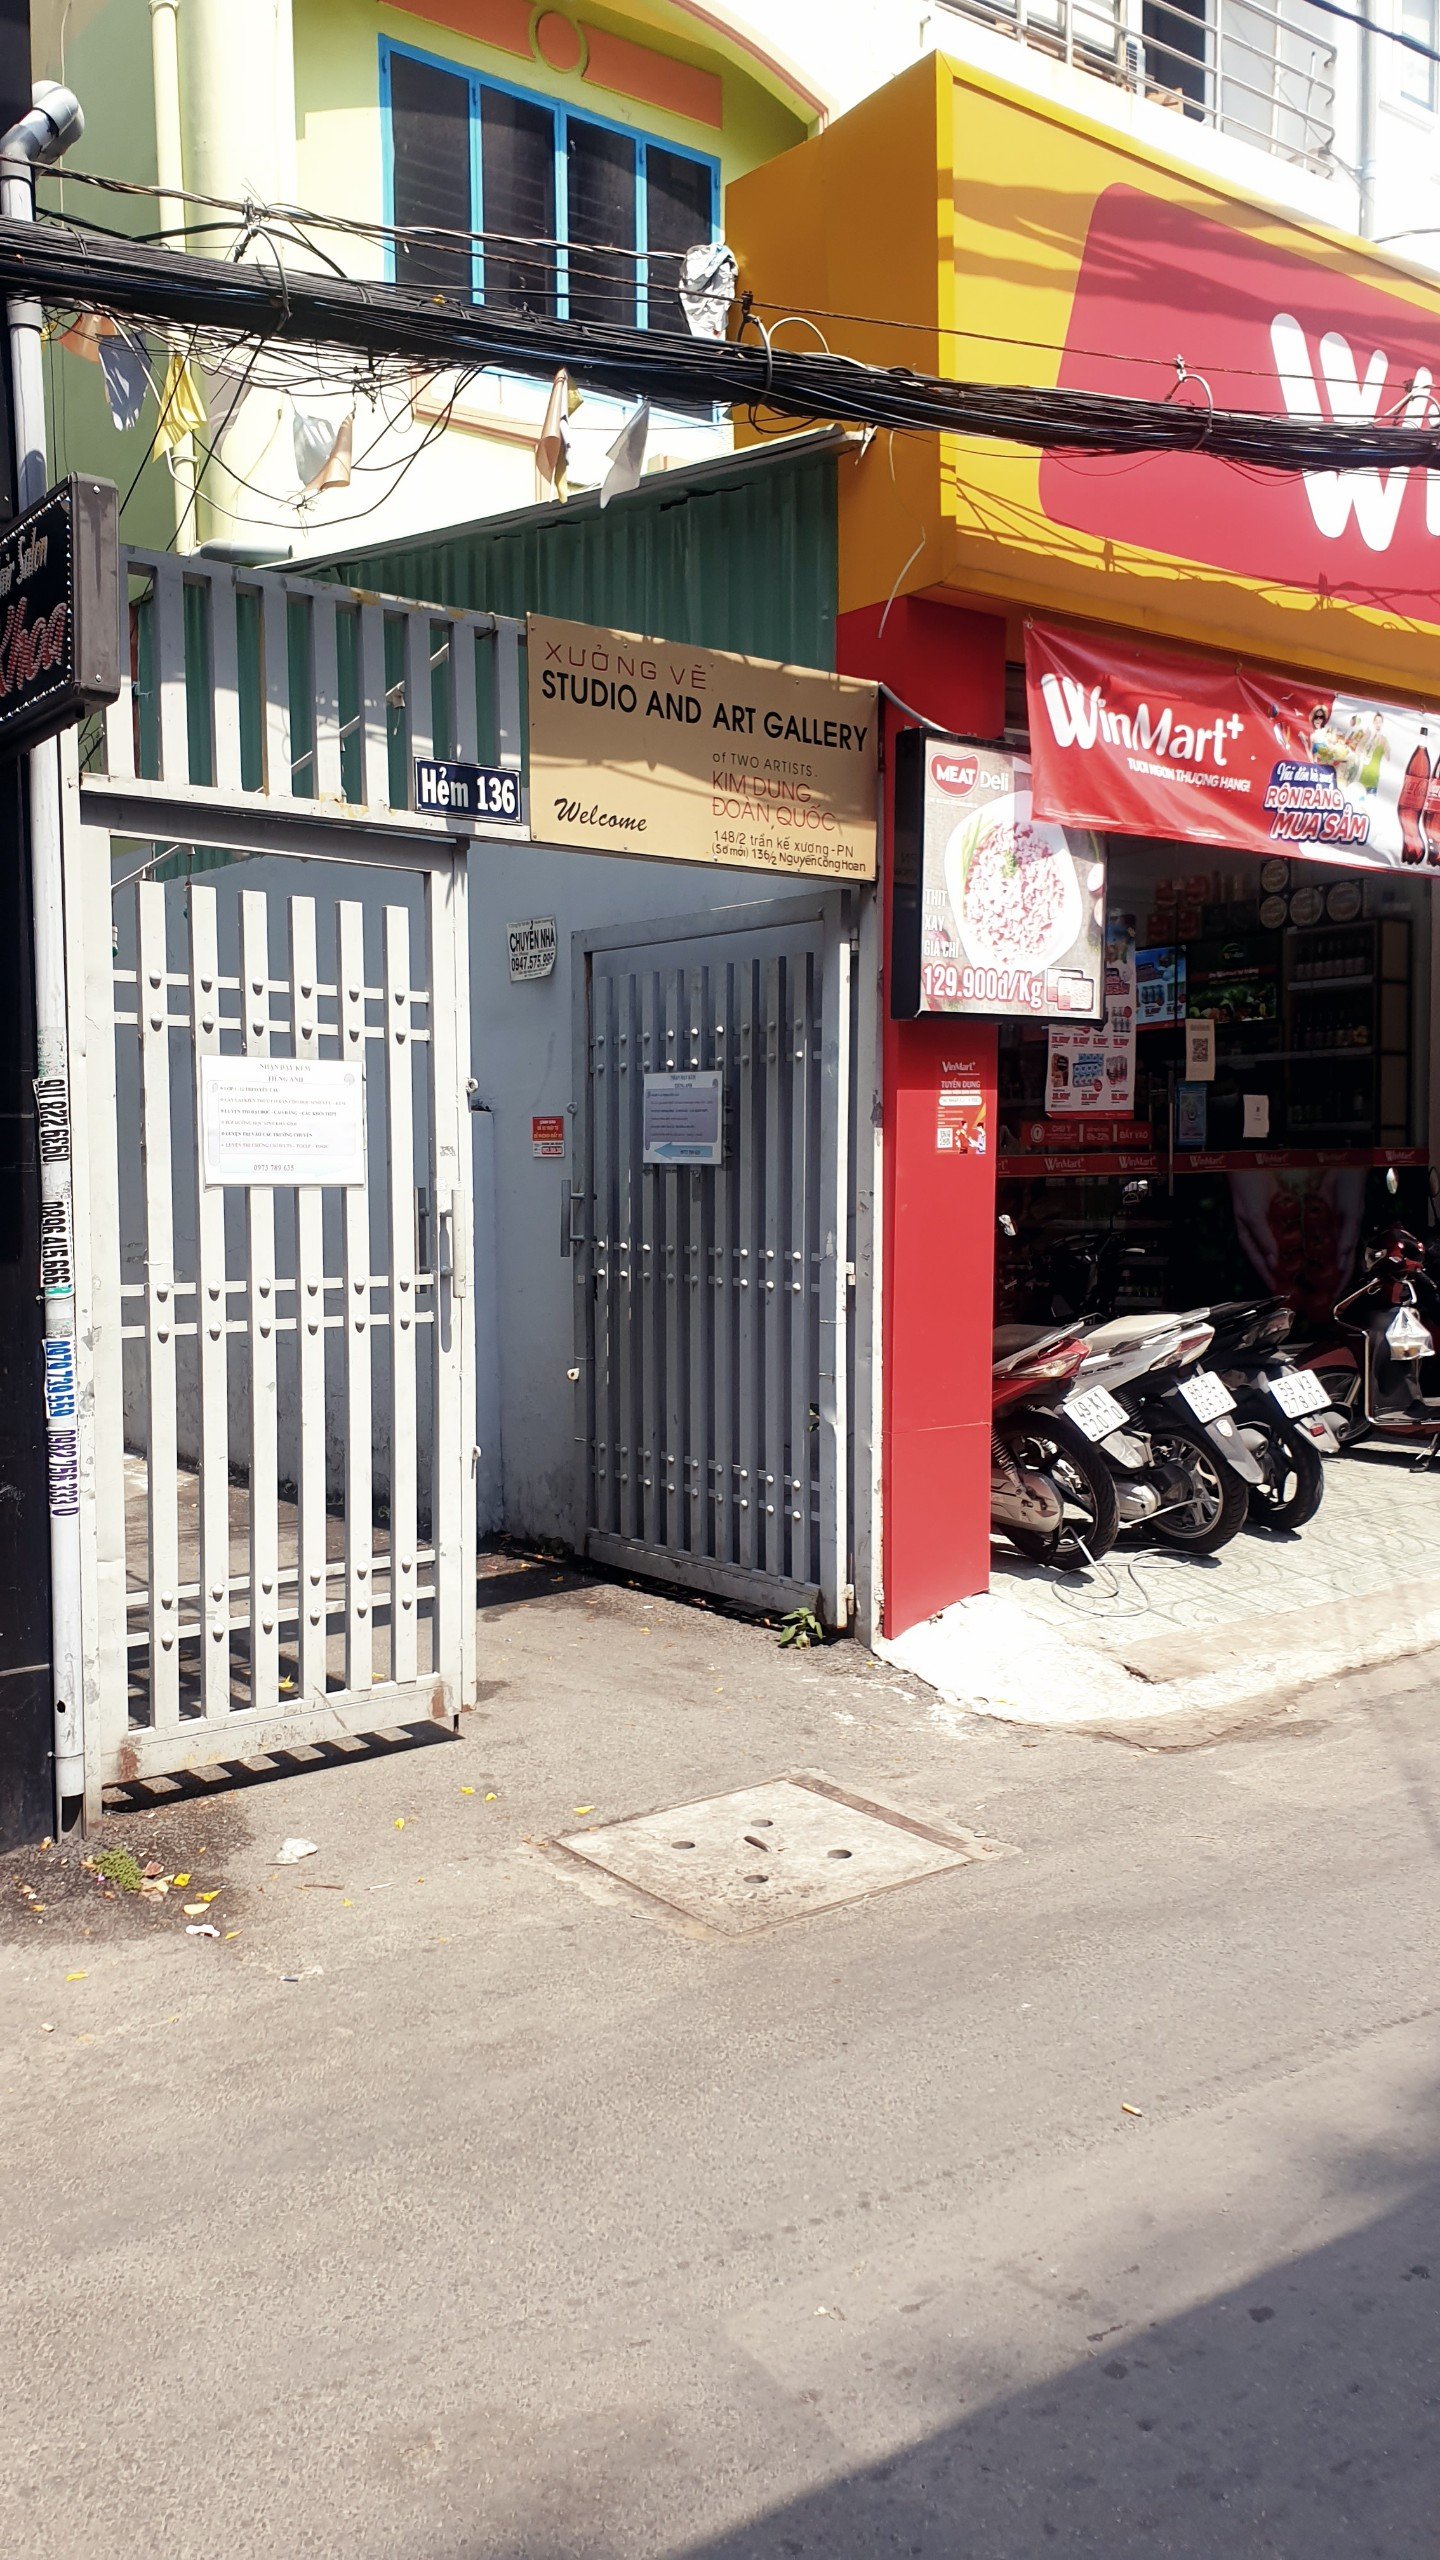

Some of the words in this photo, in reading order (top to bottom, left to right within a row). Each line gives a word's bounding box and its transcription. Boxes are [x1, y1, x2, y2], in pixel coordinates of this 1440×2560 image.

[545, 641, 657, 681] XƯỞNG
[669, 664, 707, 690] VẼ
[541, 669, 638, 713] STUDIO
[645, 690, 702, 724] AND
[712, 702, 757, 734] ART
[763, 711, 868, 752] GALLERY
[712, 751, 727, 763] of
[731, 753, 759, 769] TWO
[421, 767, 470, 808] Hẻm
[476, 776, 516, 814] 136
[712, 770, 747, 795] KIM
[753, 776, 812, 803] DUNG
[936, 763, 976, 787] MEAT
[979, 771, 1010, 792] Deli
[553, 797, 648, 833] Welcome
[711, 796, 771, 823] ĐOÀN
[776, 804, 836, 831] QUỐC
[1270, 811, 1321, 840] MUA
[714, 830, 747, 846] 148/2
[924, 888, 949, 908] THỊT
[924, 914, 945, 933] XAY
[924, 964, 1044, 1010] 129.900đ/Kg
